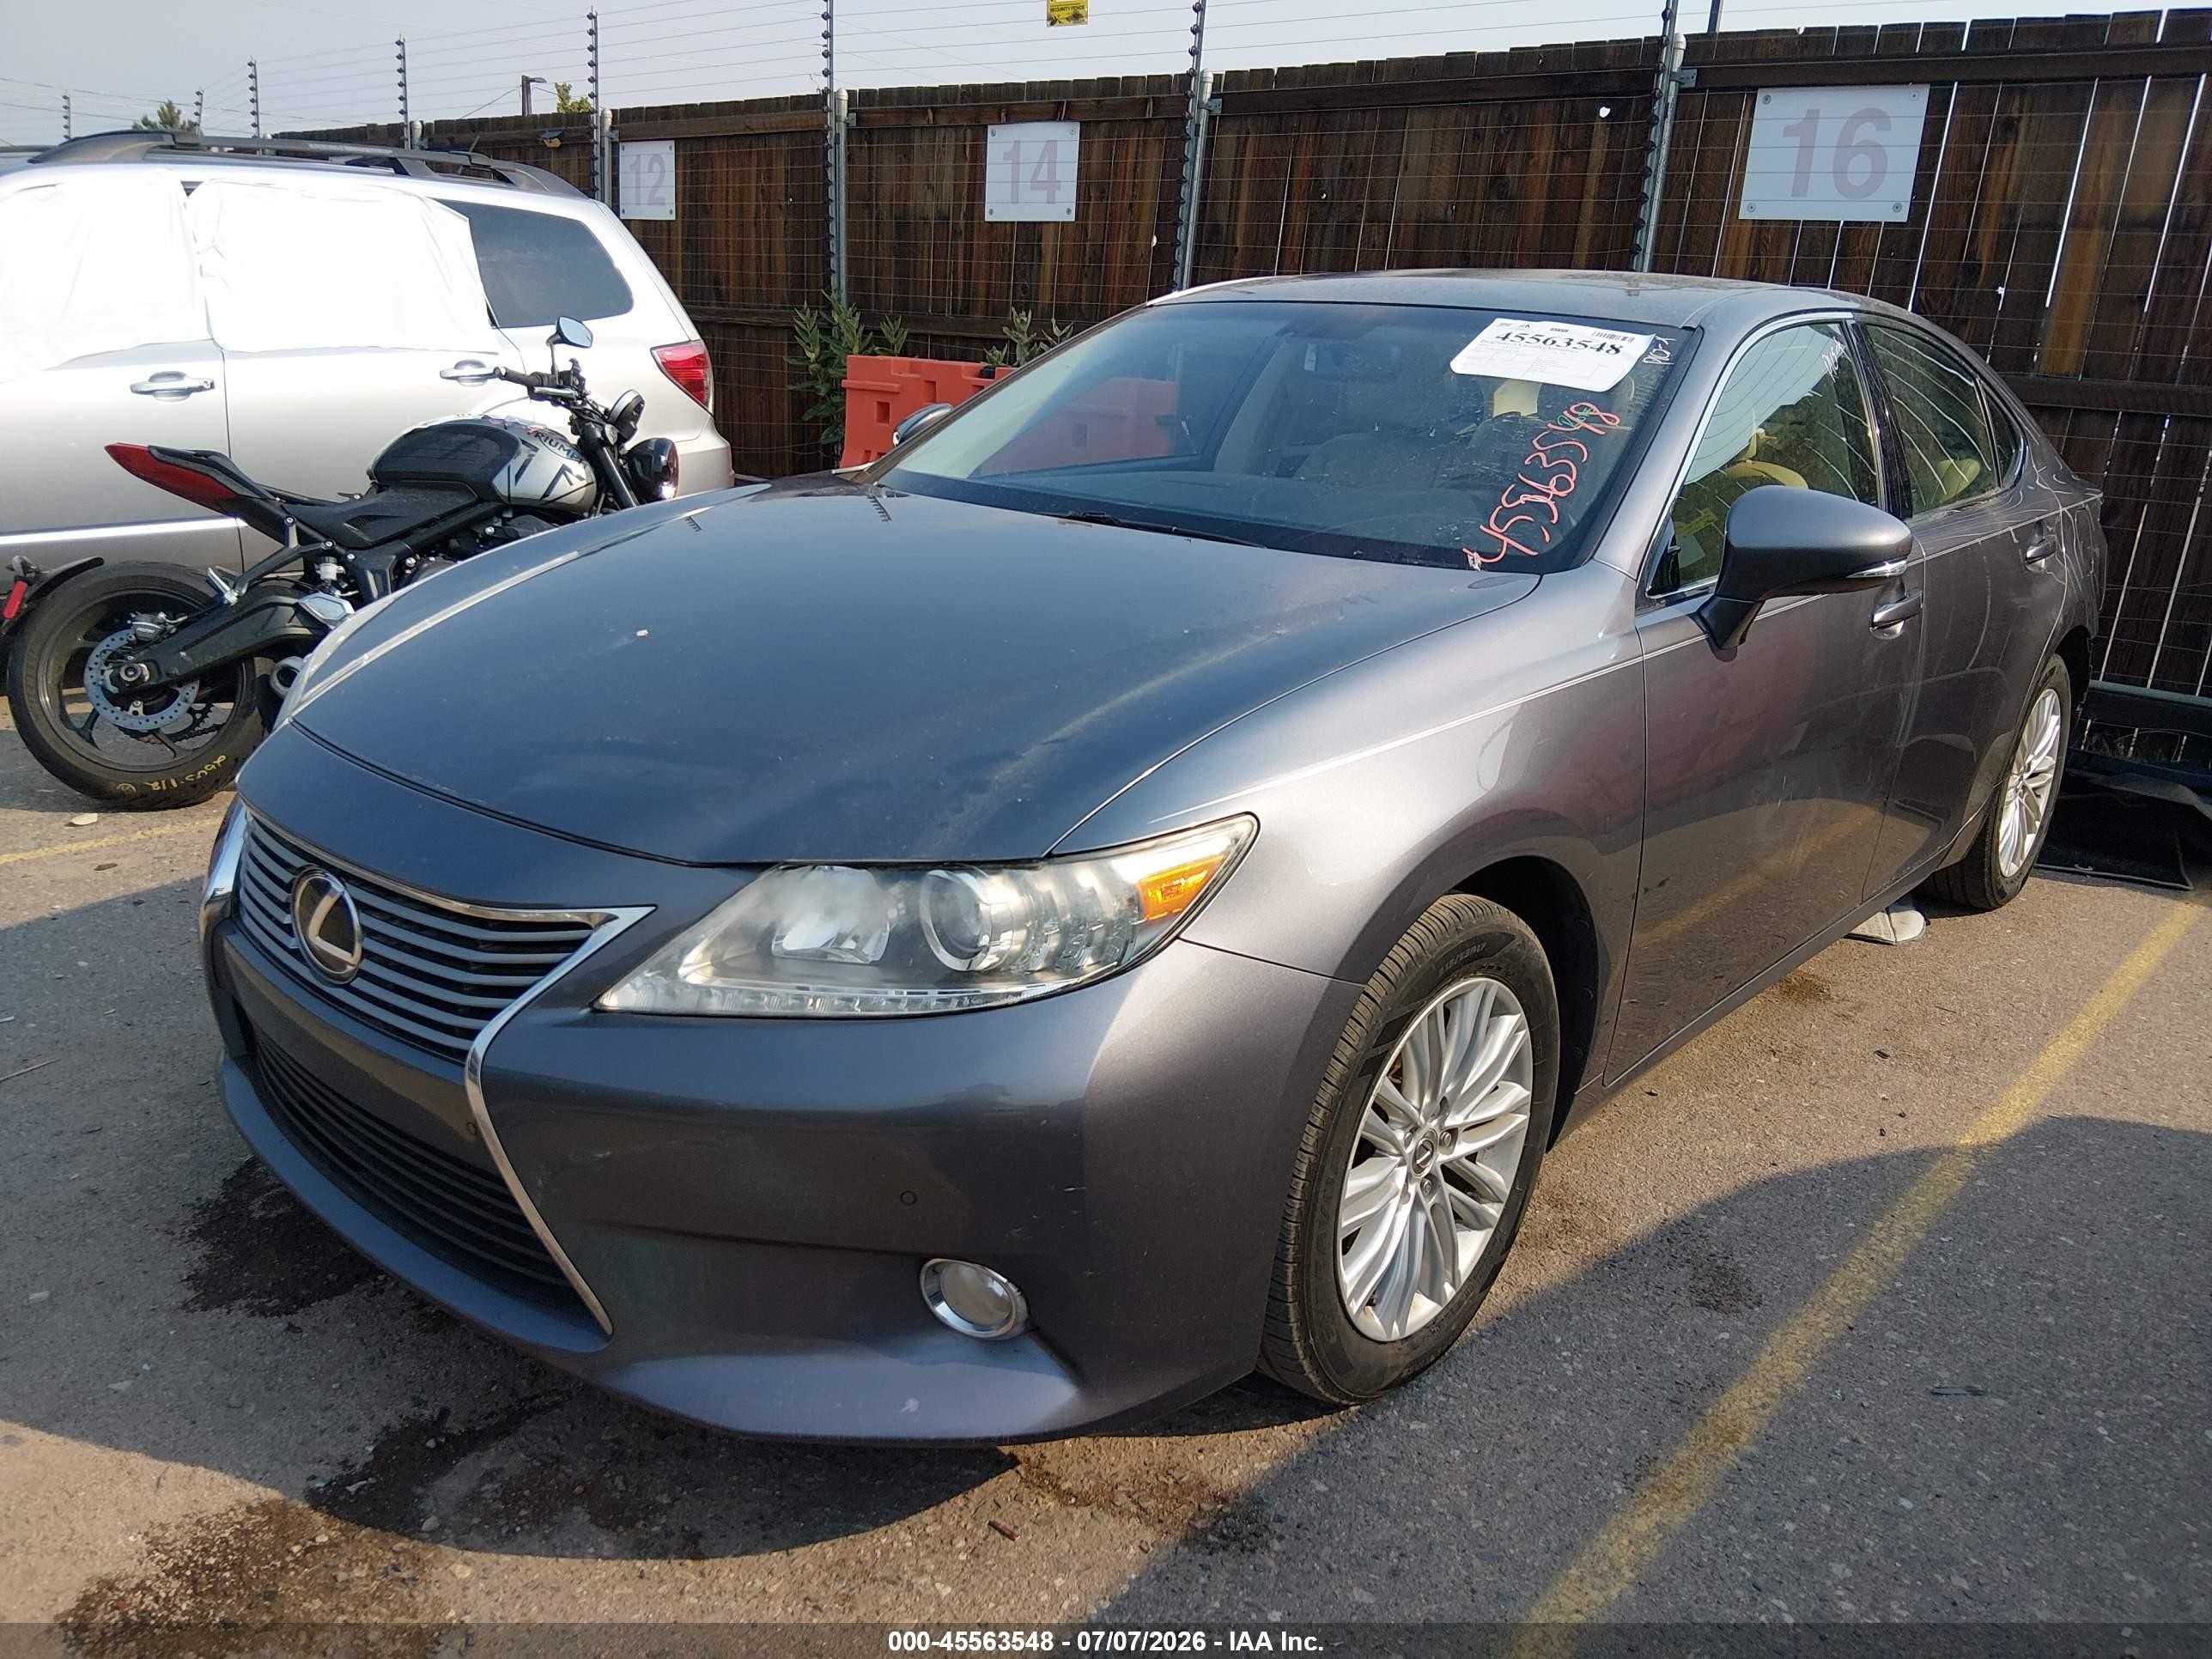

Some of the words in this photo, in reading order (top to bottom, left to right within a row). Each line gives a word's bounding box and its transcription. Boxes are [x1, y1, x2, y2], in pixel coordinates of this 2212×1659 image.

[629, 153, 666, 207] 12
[1002, 139, 1061, 205] 14
[1782, 107, 1893, 200] 16
[1495, 331, 1625, 356] 45563548
[1462, 401, 1621, 563] 45563548
